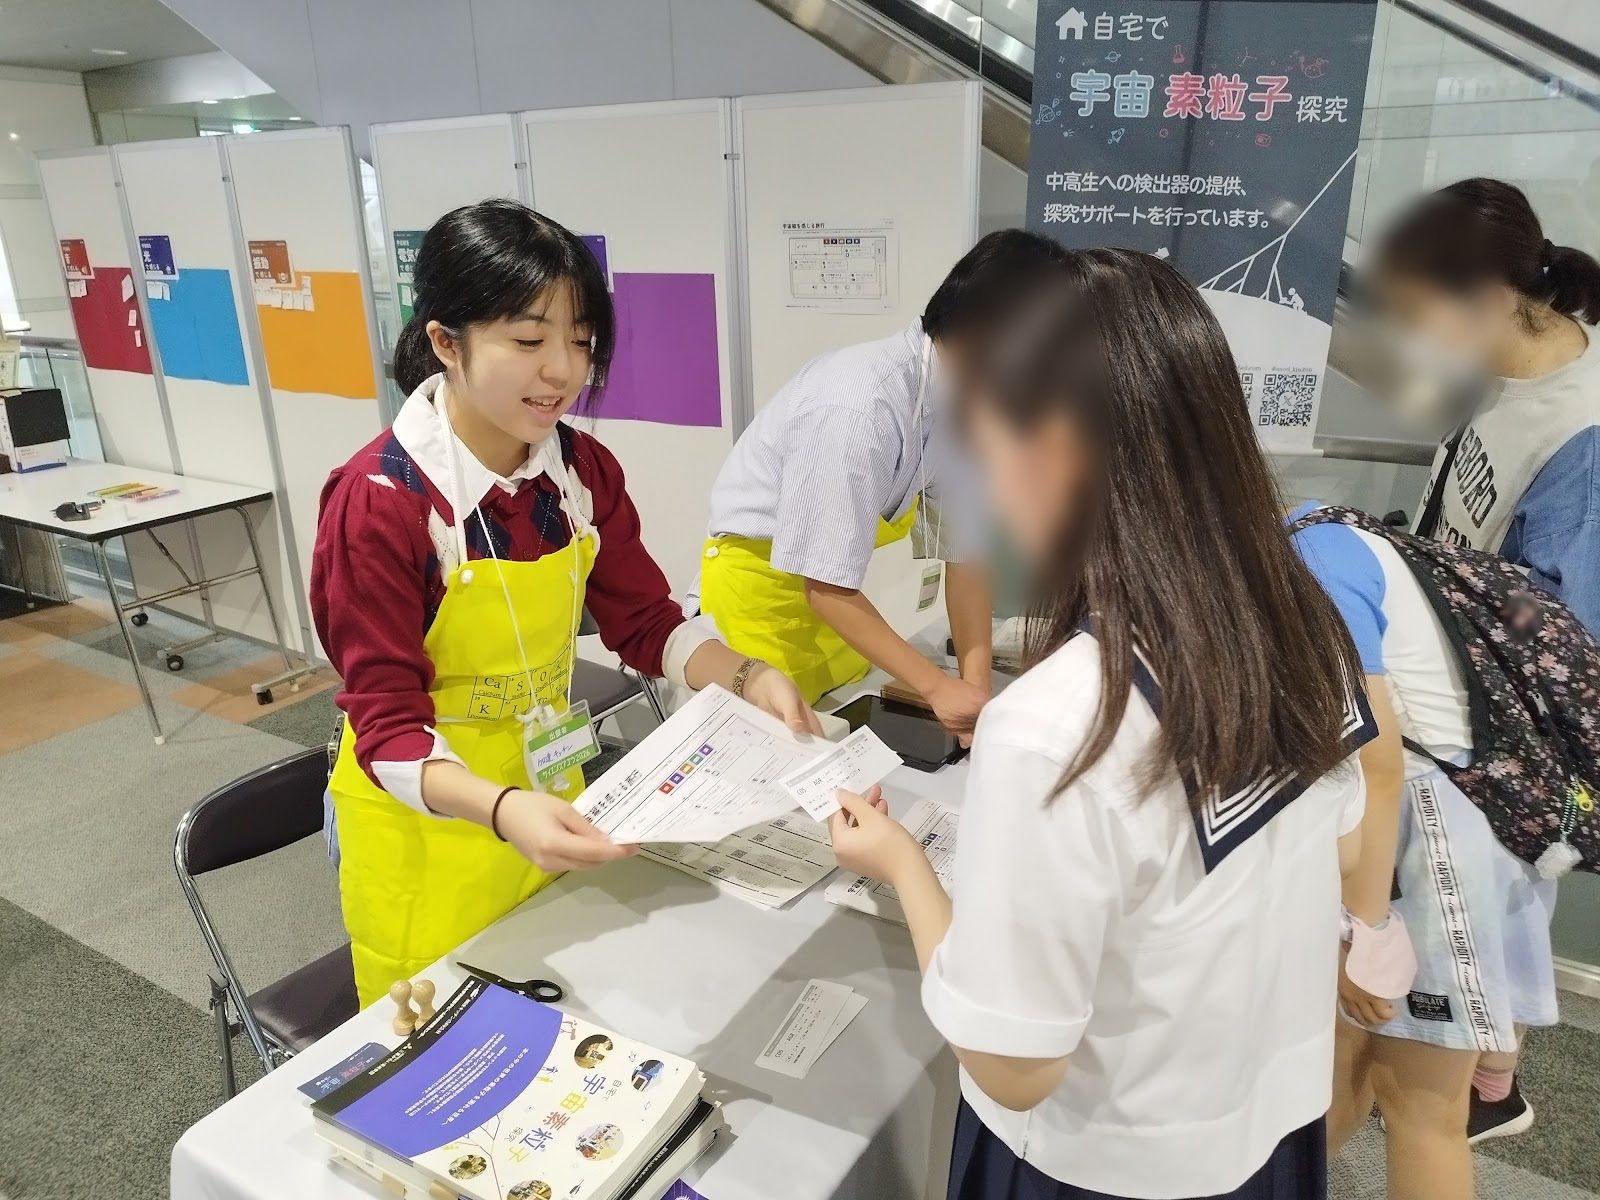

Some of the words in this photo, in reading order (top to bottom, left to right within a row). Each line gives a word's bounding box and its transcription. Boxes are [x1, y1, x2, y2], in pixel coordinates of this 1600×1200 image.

[1093, 11, 1169, 41] 自宅で
[1069, 68, 1155, 119] 宇宙
[1163, 71, 1293, 121] 素粒子
[1295, 95, 1349, 124] 探究
[1045, 170, 1248, 198] 中高生への検出器の提供、
[1042, 202, 1270, 229] 探究サポートを行っています。
[484, 677, 500, 688] Ca
[516, 681, 524, 691] S
[479, 704, 491, 715] K
[1419, 788, 1438, 828] RAPIDITY
[1436, 861, 1455, 897] RAPIDITY
[1452, 929, 1472, 967] RAPIDITY
[1469, 999, 1491, 1036] RAPIDITY
